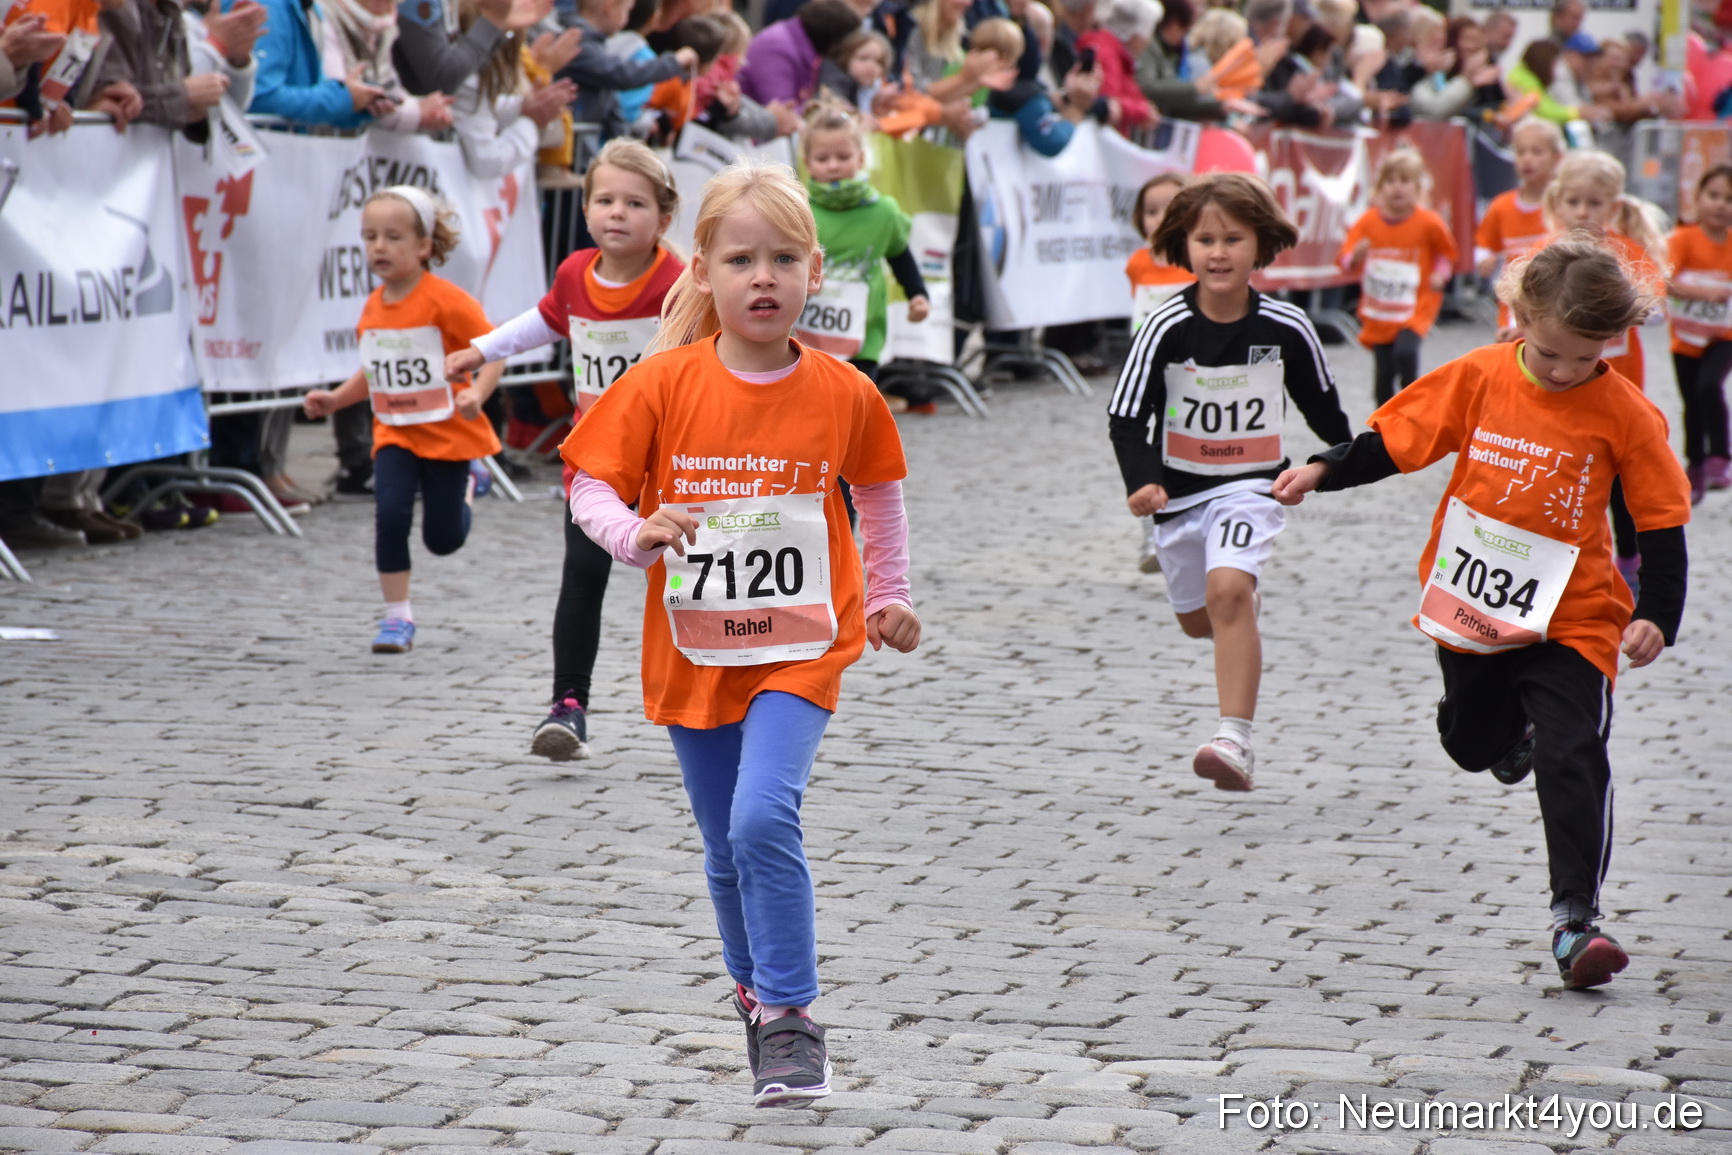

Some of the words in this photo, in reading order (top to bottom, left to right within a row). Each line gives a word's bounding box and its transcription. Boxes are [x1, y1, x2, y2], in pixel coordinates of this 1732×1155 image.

[0, 267, 134, 328] AIL.ONE
[371, 358, 431, 387] 7153
[582, 353, 641, 388] 712
[1183, 397, 1265, 433] 7012
[1200, 445, 1244, 457] Sandra
[1473, 427, 1553, 458] Neumarkter
[672, 454, 788, 473] Neumarkter
[1468, 445, 1530, 475] Stadtlauf
[674, 477, 764, 497] Stadtlauf
[1571, 454, 1594, 529] BAMBINI
[722, 512, 780, 528] BOCK
[1220, 519, 1254, 548] 10
[1482, 530, 1532, 556] BOCK
[687, 546, 803, 600] 7120
[1435, 571, 1443, 581] B1
[1451, 546, 1539, 618] 7034
[669, 595, 680, 604] B1
[724, 616, 772, 636] Rahel
[1454, 607, 1498, 640] Patricia
